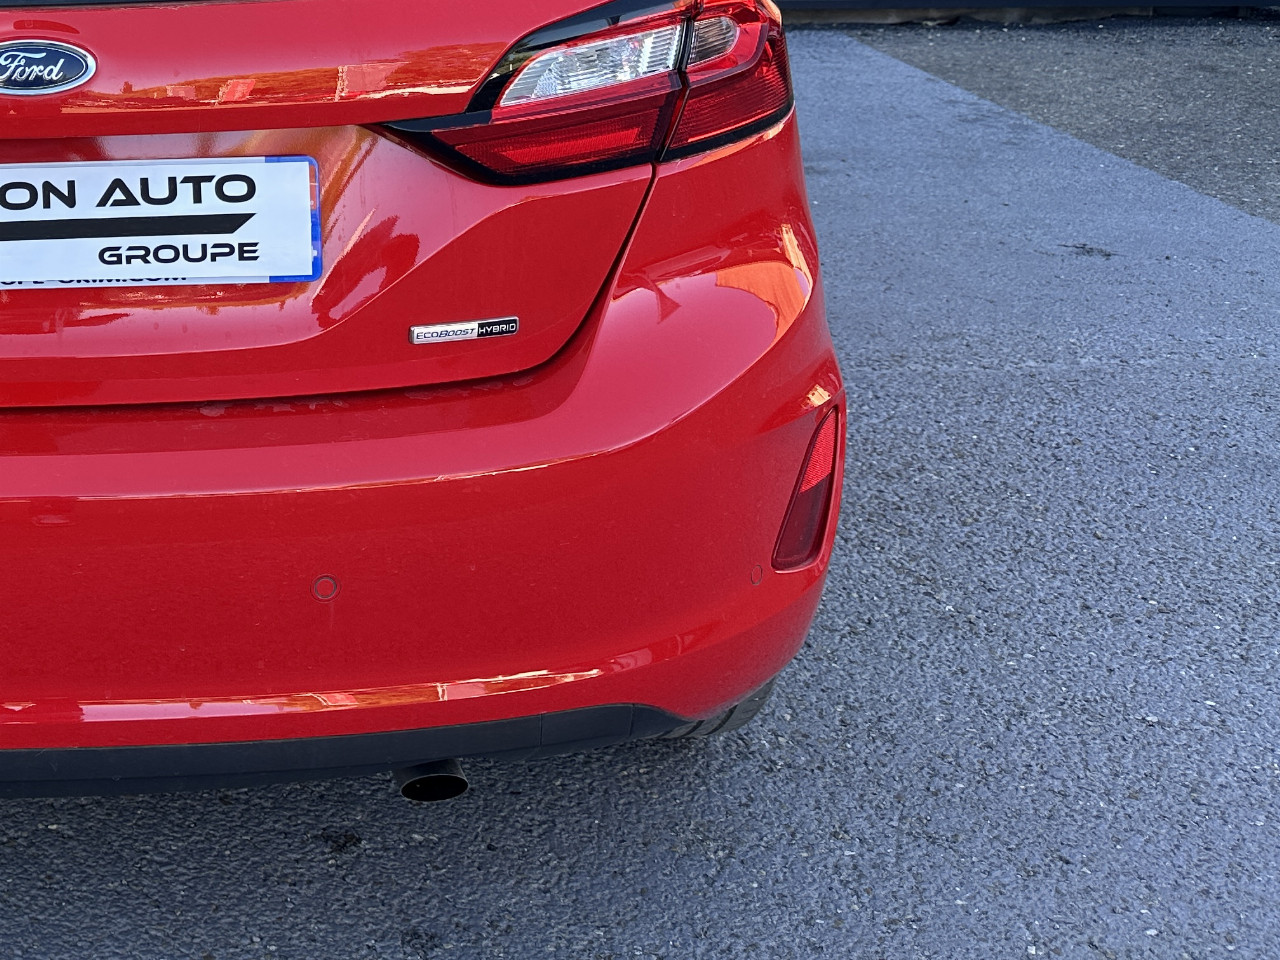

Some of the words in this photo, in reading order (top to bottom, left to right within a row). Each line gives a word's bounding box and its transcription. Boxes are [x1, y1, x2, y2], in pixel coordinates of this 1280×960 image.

[95, 173, 257, 208] AUTO
[97, 241, 261, 266] GROUPE
[478, 323, 517, 335] HYBRID
